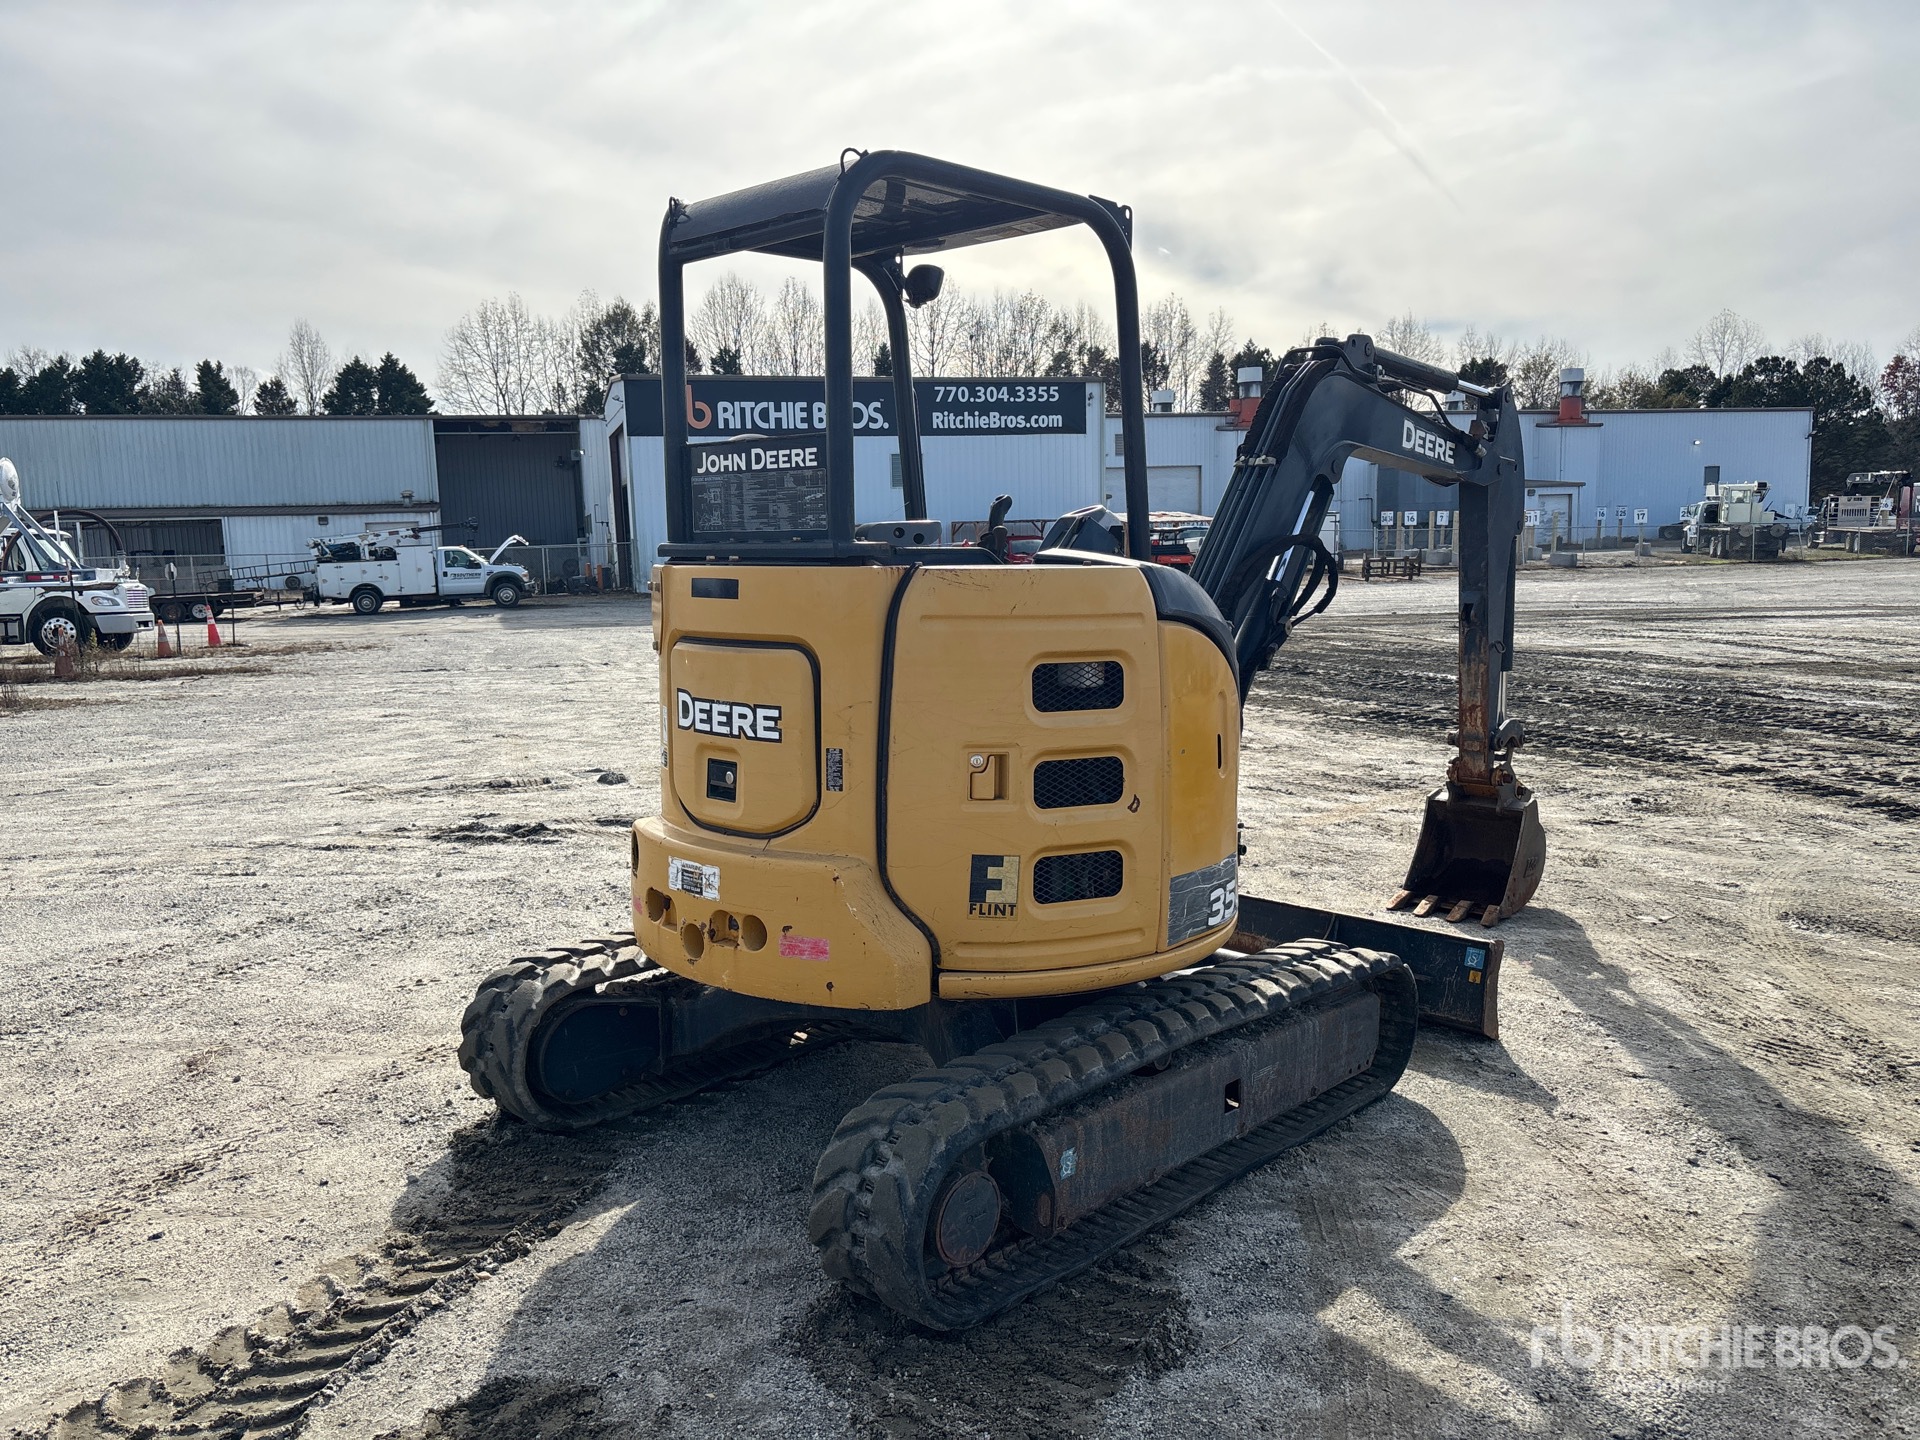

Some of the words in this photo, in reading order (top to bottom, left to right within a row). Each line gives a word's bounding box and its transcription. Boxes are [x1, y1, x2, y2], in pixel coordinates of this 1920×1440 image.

[933, 386, 1060, 403] 770.304.3355
[716, 401, 809, 430] RITCHIE
[812, 401, 890, 430] BOS.
[932, 411, 1063, 429] RitchieBros.com
[1401, 418, 1456, 465] DEERE
[750, 447, 818, 471] DEERE
[677, 690, 781, 741] DEERE
[969, 903, 1017, 917] FLINT
